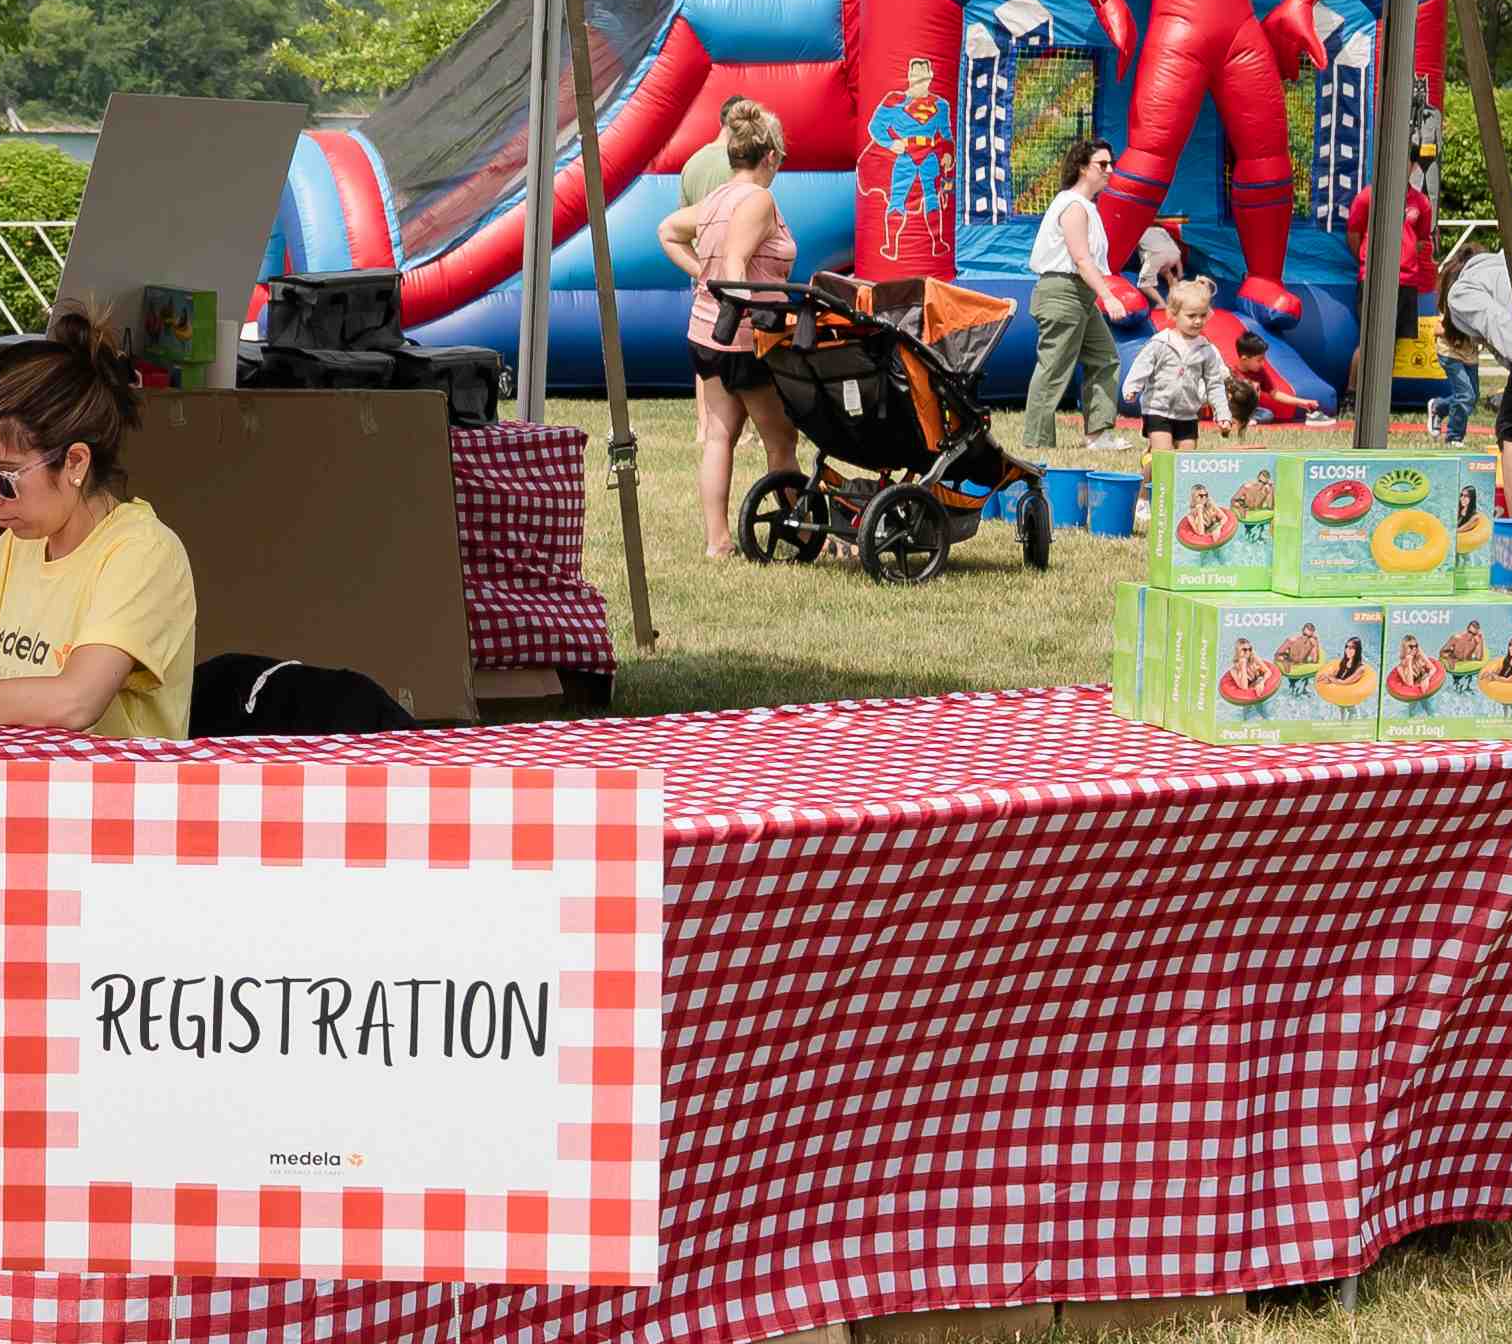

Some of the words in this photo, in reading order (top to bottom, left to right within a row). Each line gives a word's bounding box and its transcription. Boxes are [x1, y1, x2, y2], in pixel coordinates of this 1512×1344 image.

[1180, 459, 1240, 473] SLOOSH
[1309, 465, 1367, 480] SLOOSH
[1223, 611, 1284, 627] SLOOSH
[1391, 609, 1451, 624] SLOOSH
[91, 973, 551, 1067] REGISTRATION
[269, 1151, 341, 1166] medela
